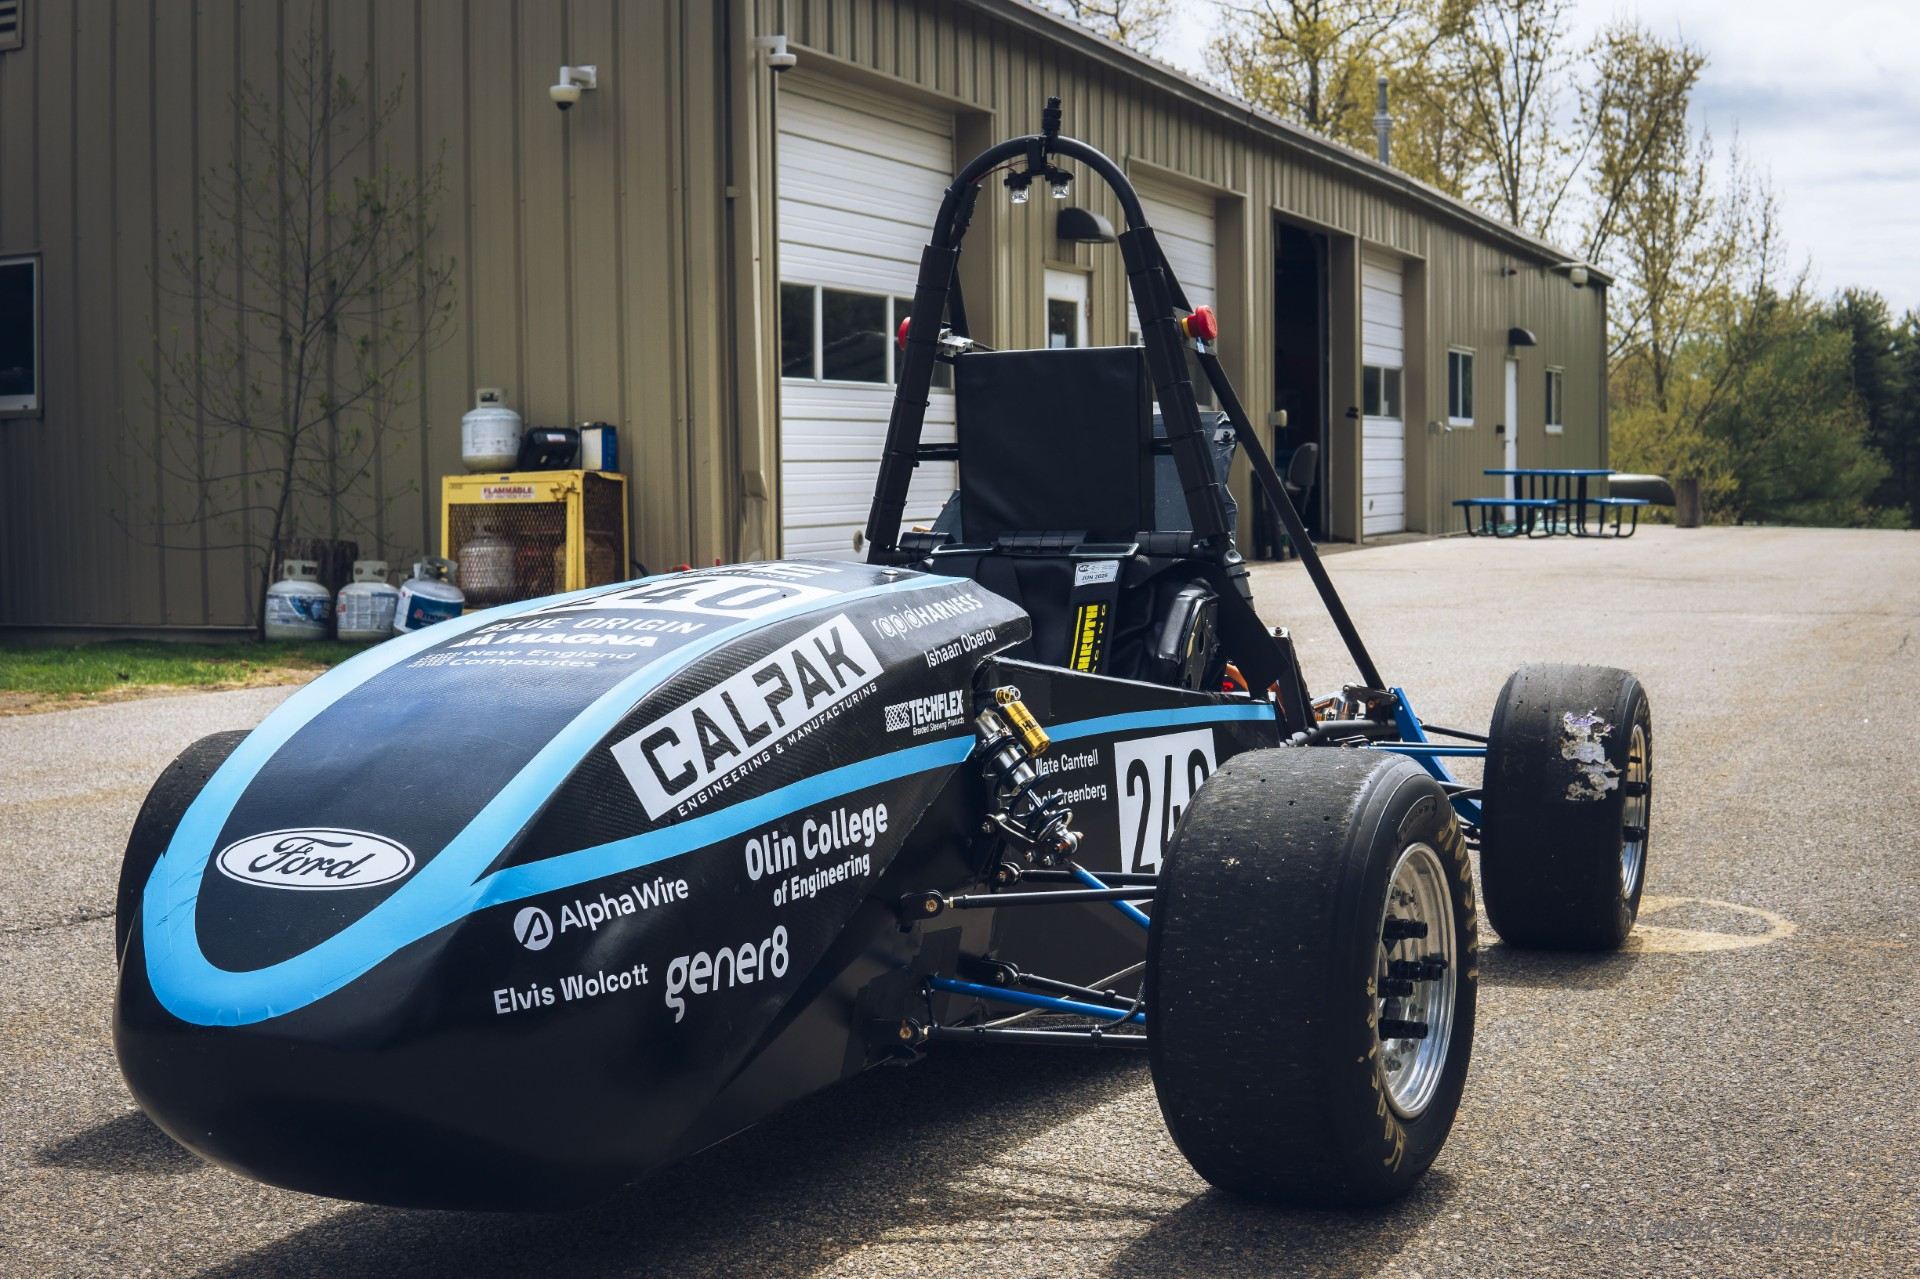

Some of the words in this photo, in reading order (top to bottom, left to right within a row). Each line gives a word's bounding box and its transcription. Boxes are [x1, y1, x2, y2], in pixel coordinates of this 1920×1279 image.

[484, 486, 532, 494] FLAMMABLE
[475, 617, 574, 634] BLUE
[573, 617, 706, 635] ORIGIN
[870, 593, 984, 640] rapidHARNESS
[449, 657, 598, 668] Composites
[464, 649, 521, 657] New
[527, 649, 637, 660] England
[492, 633, 658, 648] MAGNA
[924, 641, 963, 668] Ishaan
[960, 624, 996, 651] Oberoi
[640, 626, 867, 797] CALPAK
[908, 689, 964, 726] TECHFLEX
[676, 750, 773, 817] ENGINEERING
[775, 742, 785, 754] &
[787, 682, 878, 747] MANUFACTURING
[1036, 756, 1059, 775] Nate
[1061, 749, 1099, 772] Cantrell
[248, 836, 375, 880] Ford
[745, 829, 797, 881] Olin
[802, 803, 889, 860] College
[773, 884, 788, 907] of
[791, 854, 871, 901] Engineering
[494, 982, 555, 1015] Elvis
[560, 963, 649, 1001] Wolcott
[665, 925, 790, 1023] gener8
